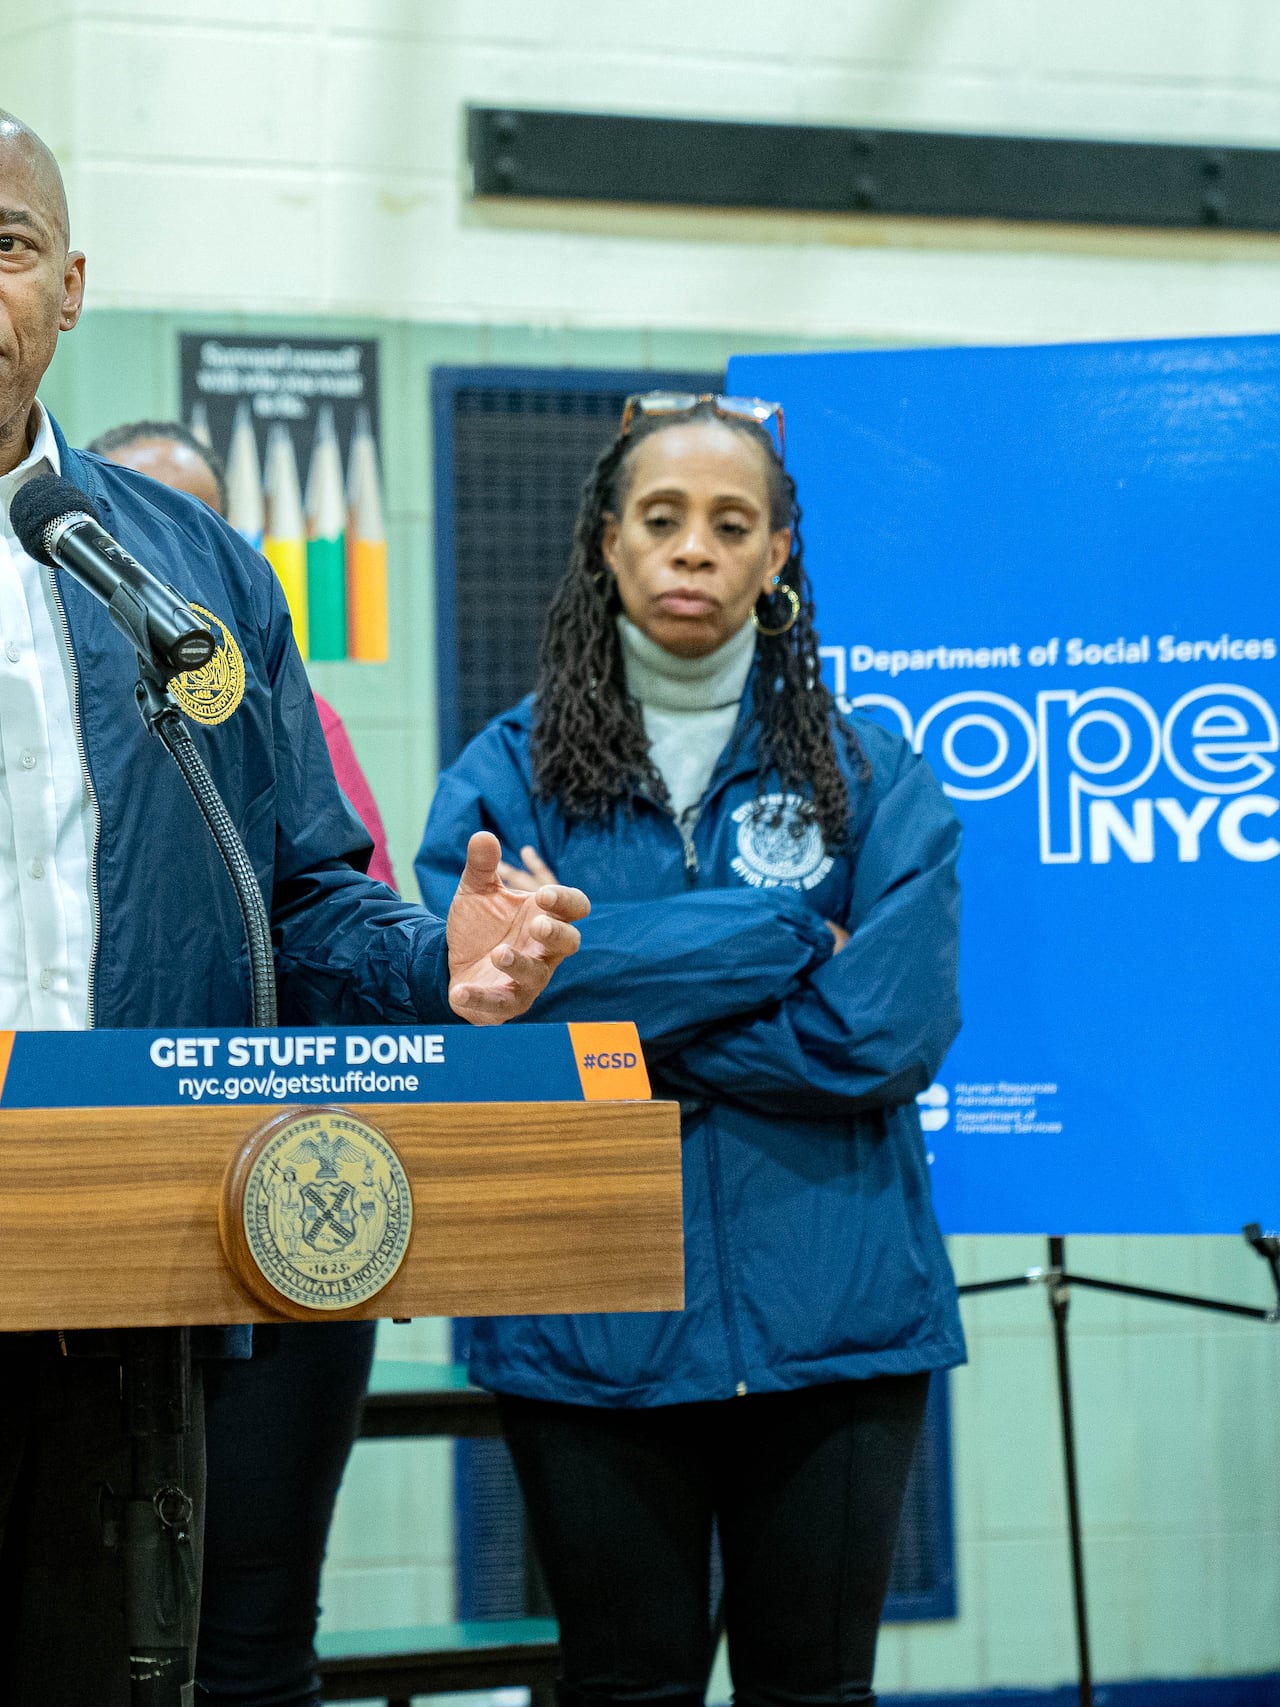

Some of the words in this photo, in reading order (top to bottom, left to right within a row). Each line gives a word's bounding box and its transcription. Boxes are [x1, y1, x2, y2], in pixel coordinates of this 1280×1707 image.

[850, 644, 1020, 677] Department
[1027, 637, 1060, 668] of
[1065, 635, 1150, 666] Social
[1157, 633, 1277, 664] Services
[1090, 794, 1280, 864] NYC
[150, 1037, 220, 1067] GET
[228, 1036, 336, 1066] STUFF
[345, 1034, 445, 1064] DONE
[584, 1052, 637, 1069] #GSD
[179, 1070, 419, 1100] nyc.gov/getstuffdone
